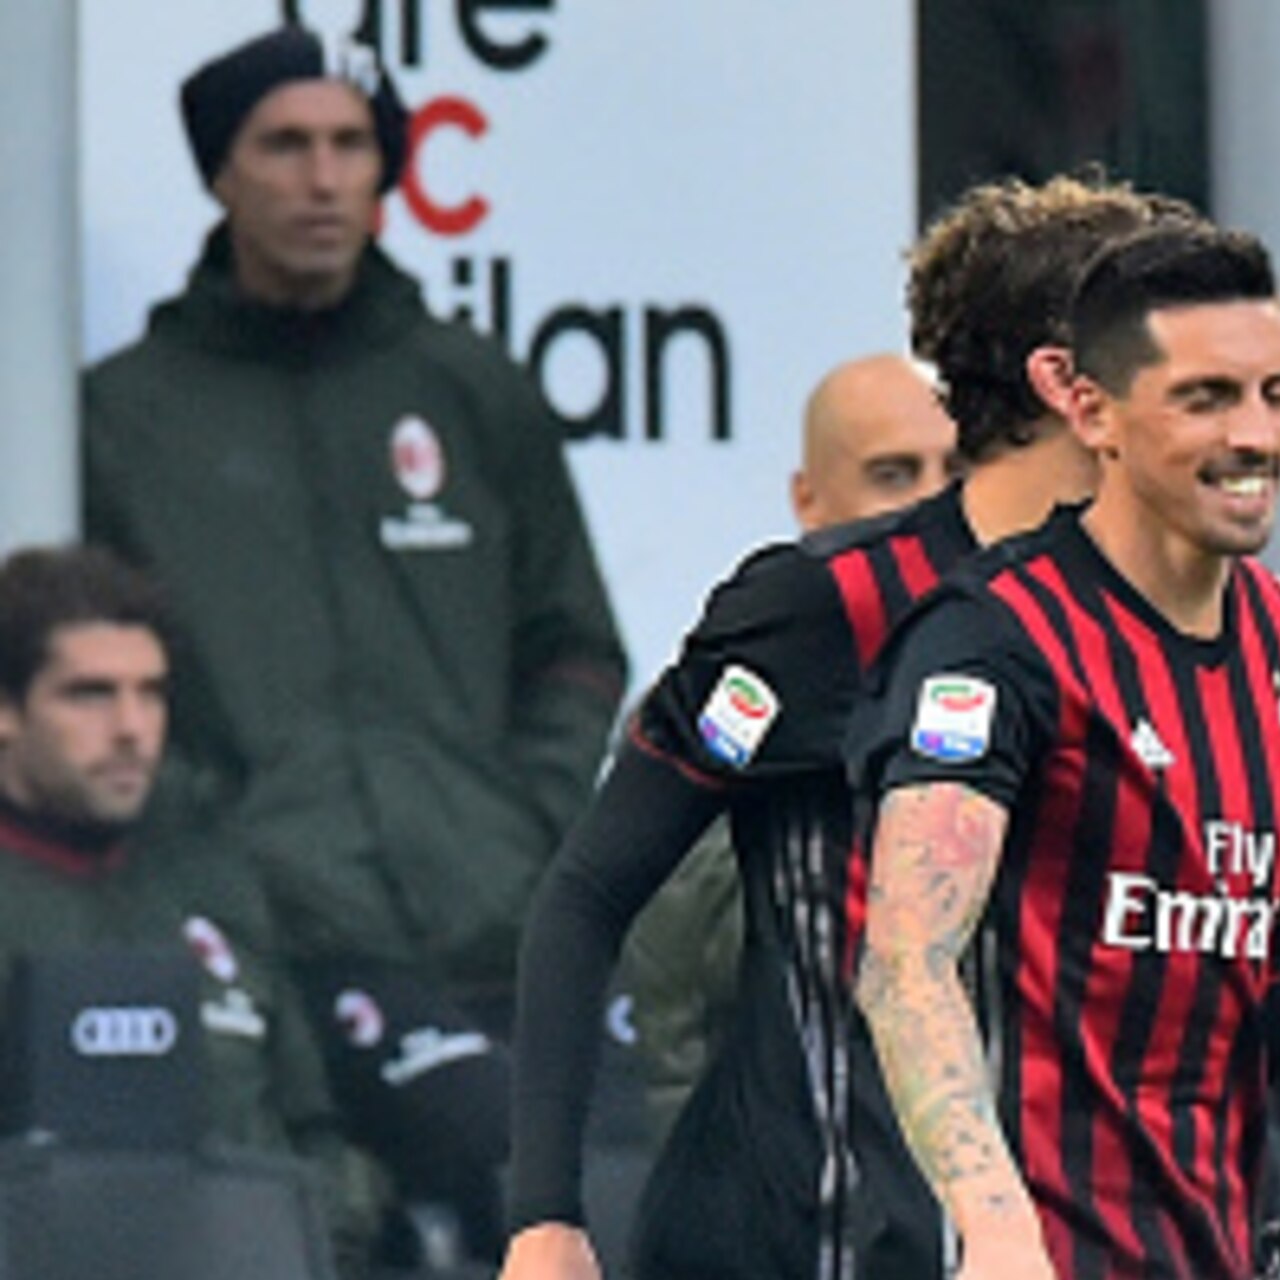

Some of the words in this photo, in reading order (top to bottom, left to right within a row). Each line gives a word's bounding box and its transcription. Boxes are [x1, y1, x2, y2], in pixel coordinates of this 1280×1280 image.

[372, 95, 490, 239] c
[450, 256, 733, 443] lan
[1205, 819, 1277, 888] Fly
